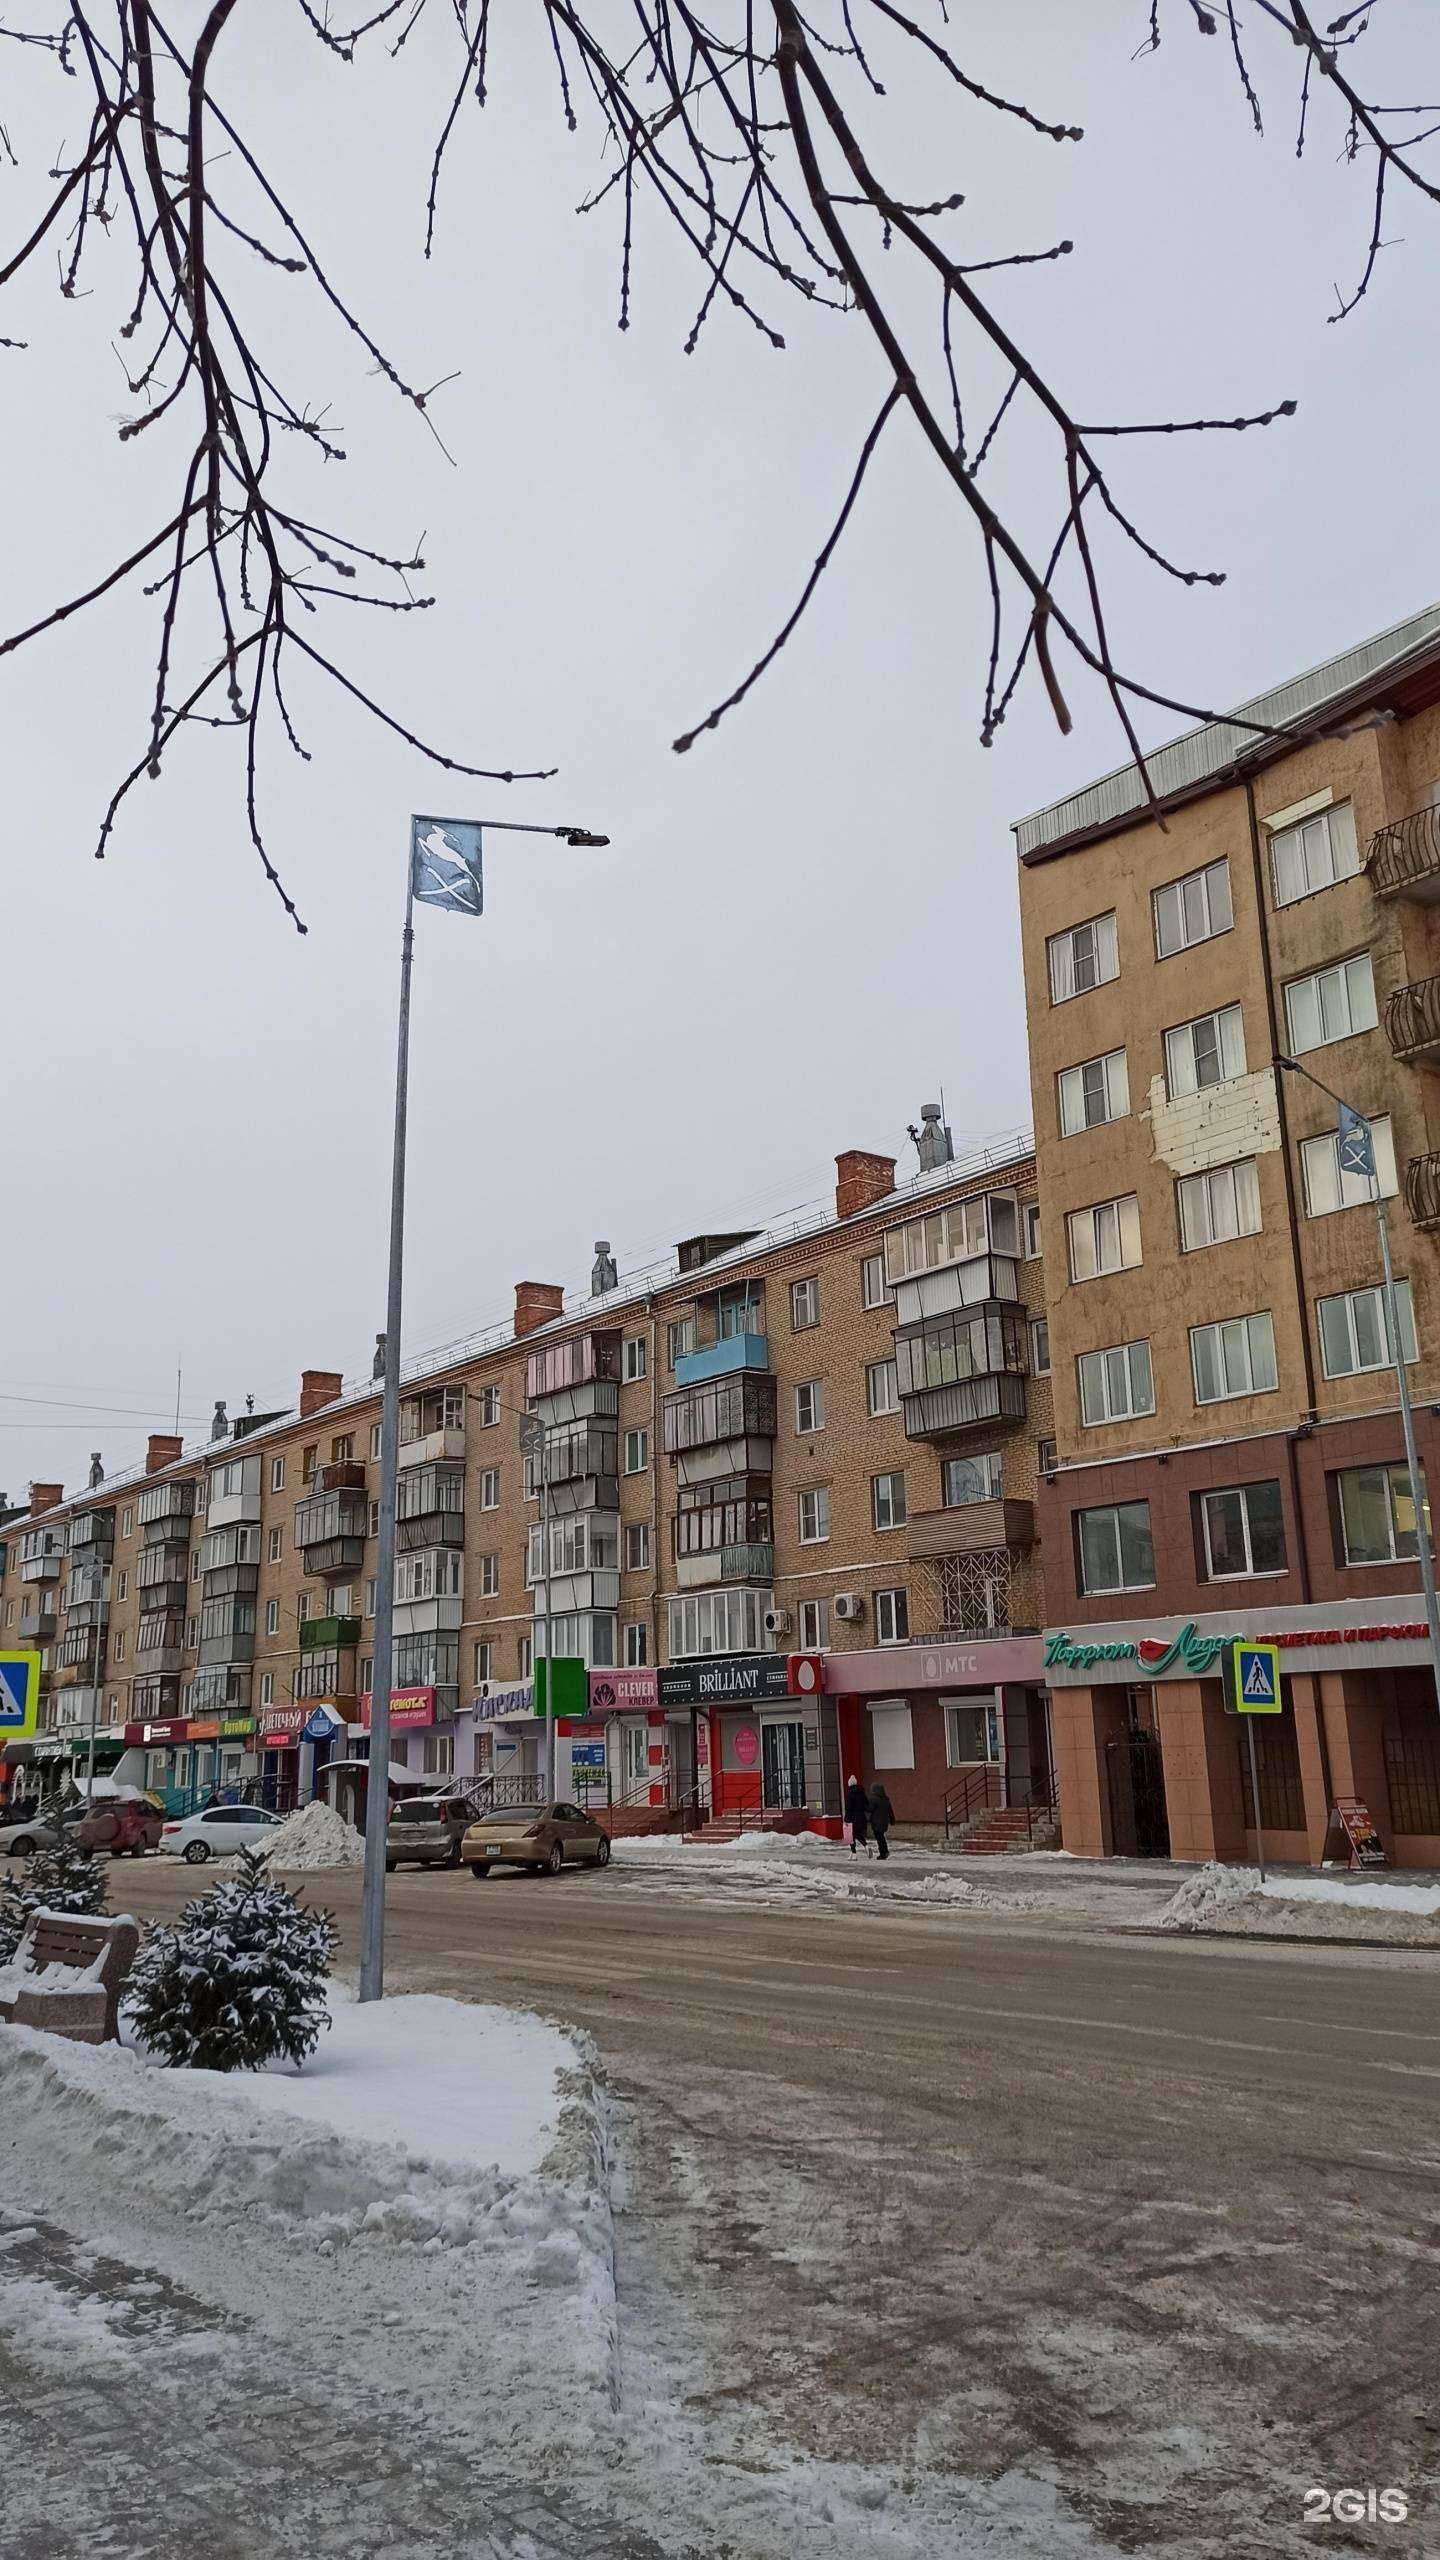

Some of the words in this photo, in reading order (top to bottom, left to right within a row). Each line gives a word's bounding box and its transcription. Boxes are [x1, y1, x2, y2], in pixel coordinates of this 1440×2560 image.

[1044, 1632, 1136, 1668] Парфюм
[945, 1656, 977, 1673] МТС
[618, 1682, 654, 1697] CLEVER
[628, 1697, 655, 1706] КЛЕВЕР
